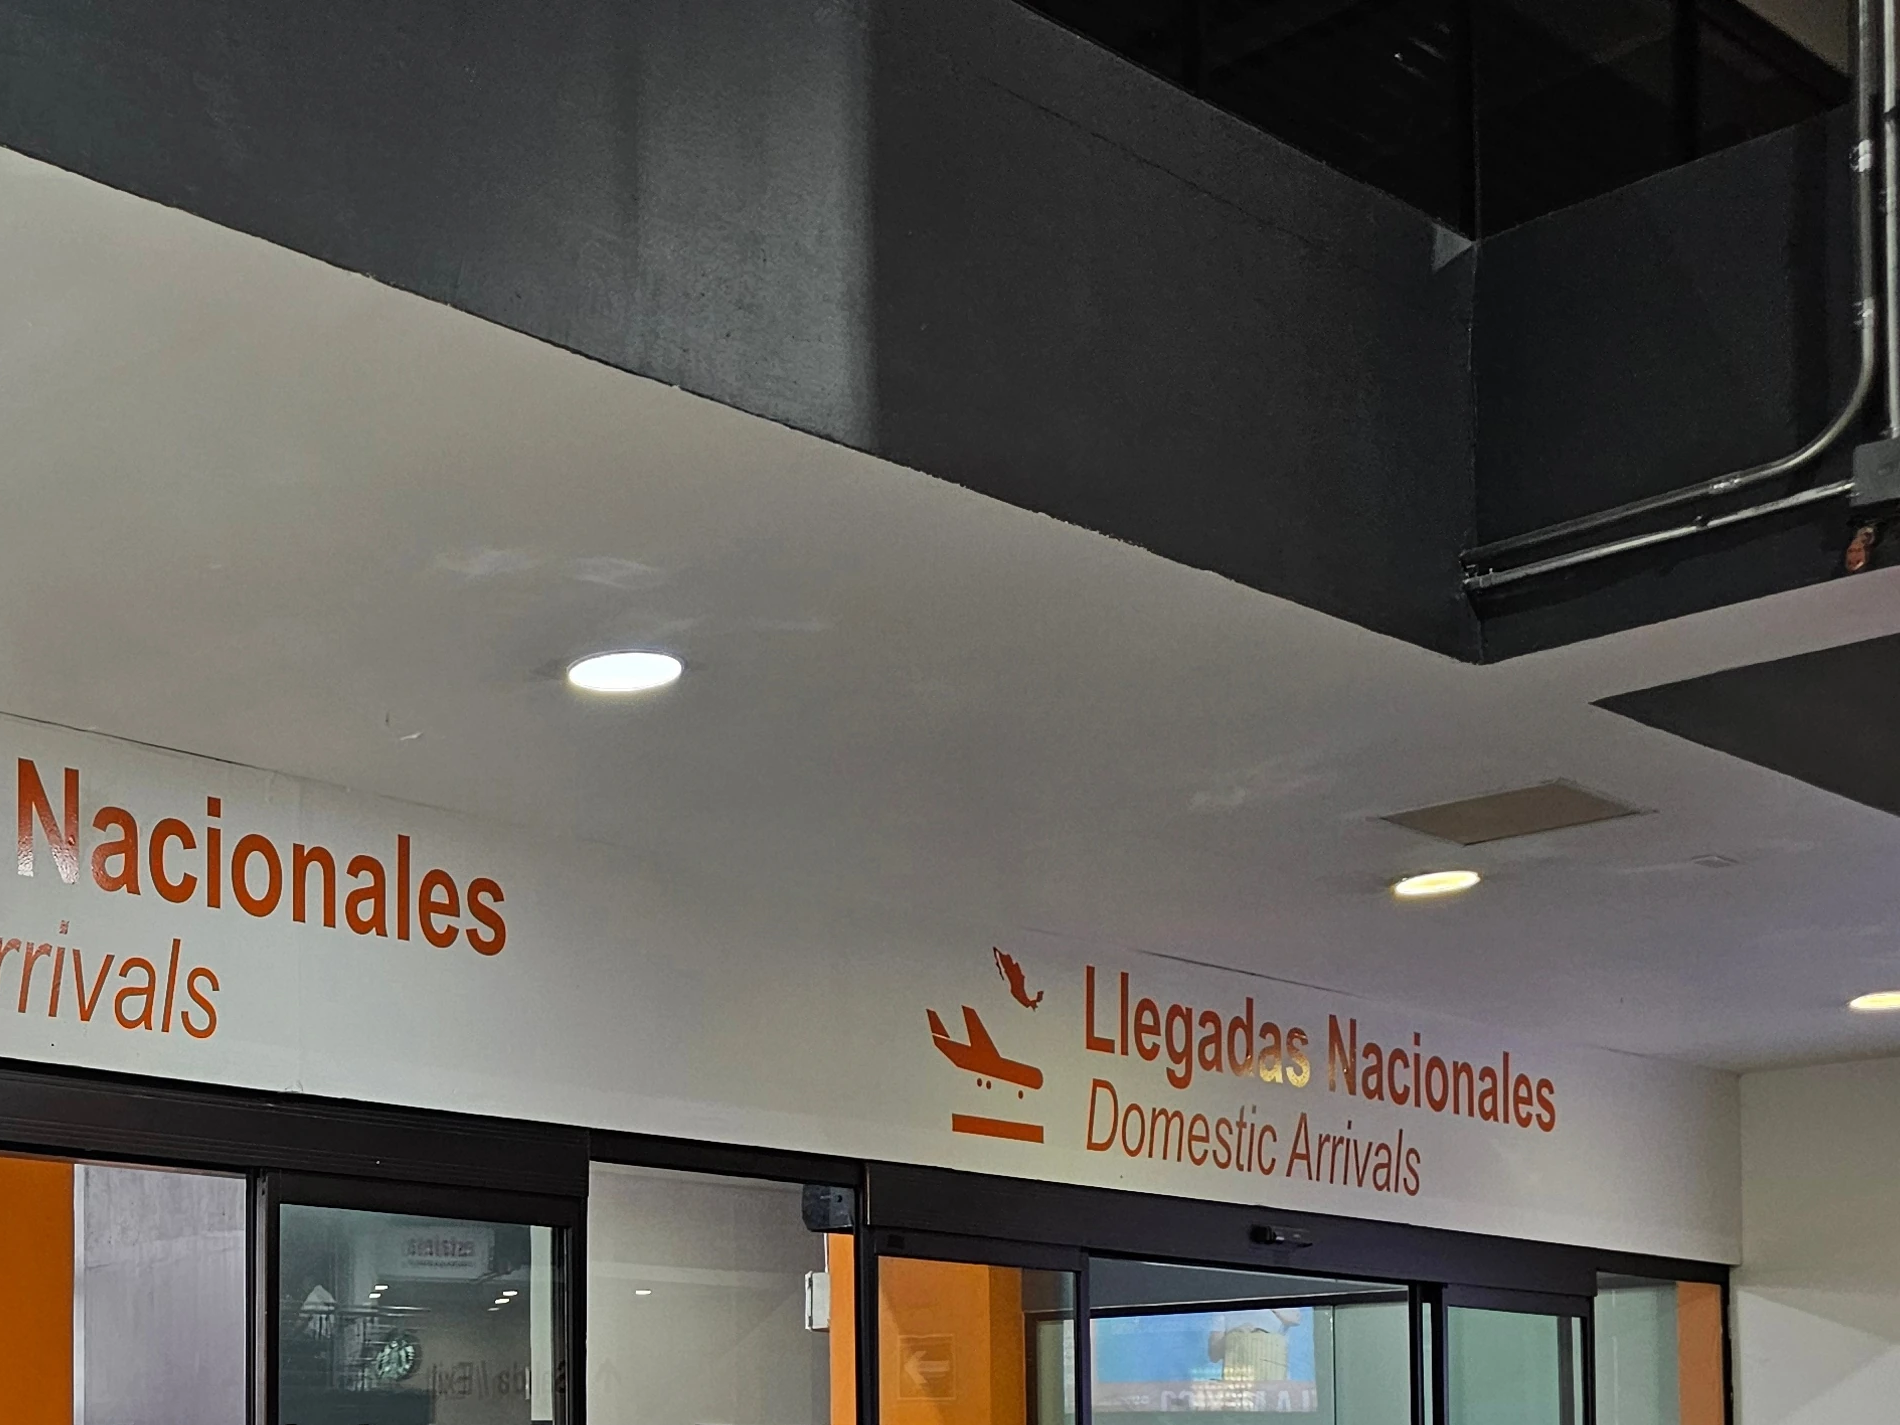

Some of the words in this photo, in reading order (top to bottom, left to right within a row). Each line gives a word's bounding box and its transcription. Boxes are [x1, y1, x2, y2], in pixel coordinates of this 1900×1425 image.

[15, 757, 507, 956] Nacionales
[1085, 965, 1309, 1090] Llegadas
[1328, 1014, 1556, 1133] Nacionales
[1086, 1078, 1277, 1176] Domestic
[1286, 1112, 1420, 1197] Arrivals
